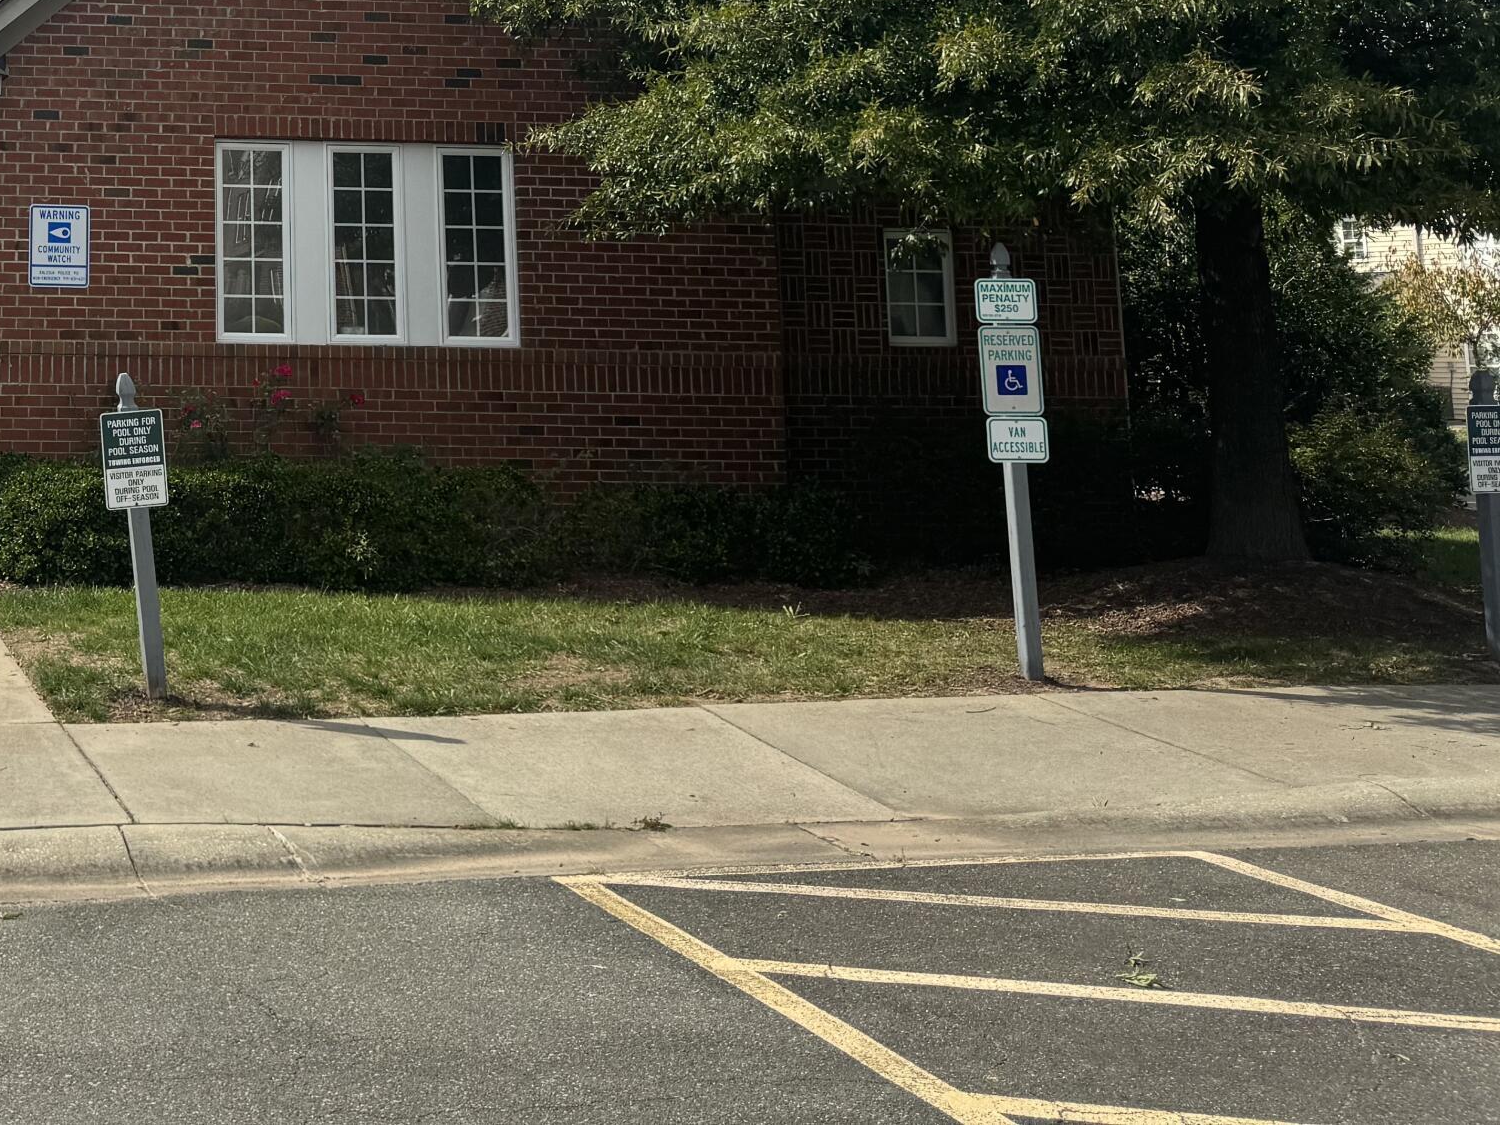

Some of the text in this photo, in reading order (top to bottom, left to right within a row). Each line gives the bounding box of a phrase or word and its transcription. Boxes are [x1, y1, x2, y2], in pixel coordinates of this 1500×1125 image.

[40, 210, 80, 219] WARNING
[38, 246, 80, 254] COMMUNITY
[48, 255, 71, 263] WATCH
[981, 284, 1030, 292] MAXIMUM
[982, 294, 1029, 302] PENALTY
[995, 304, 1018, 312] $250
[983, 335, 1034, 346] RESERVED
[988, 350, 1032, 361] PARKING
[107, 418, 139, 428] PARKING
[112, 426, 151, 437] POOL ONLY
[1009, 427, 1026, 437] VAN
[119, 436, 147, 446] DURING
[108, 444, 159, 456] POOL SEASON
[992, 442, 1045, 453] ACCESSIBLE
[108, 456, 160, 466] TOWING ENFORCED
[109, 469, 162, 480] VISITOR PARKING
[114, 486, 140, 495] DURING
[115, 492, 159, 503] OFF-SEASON
